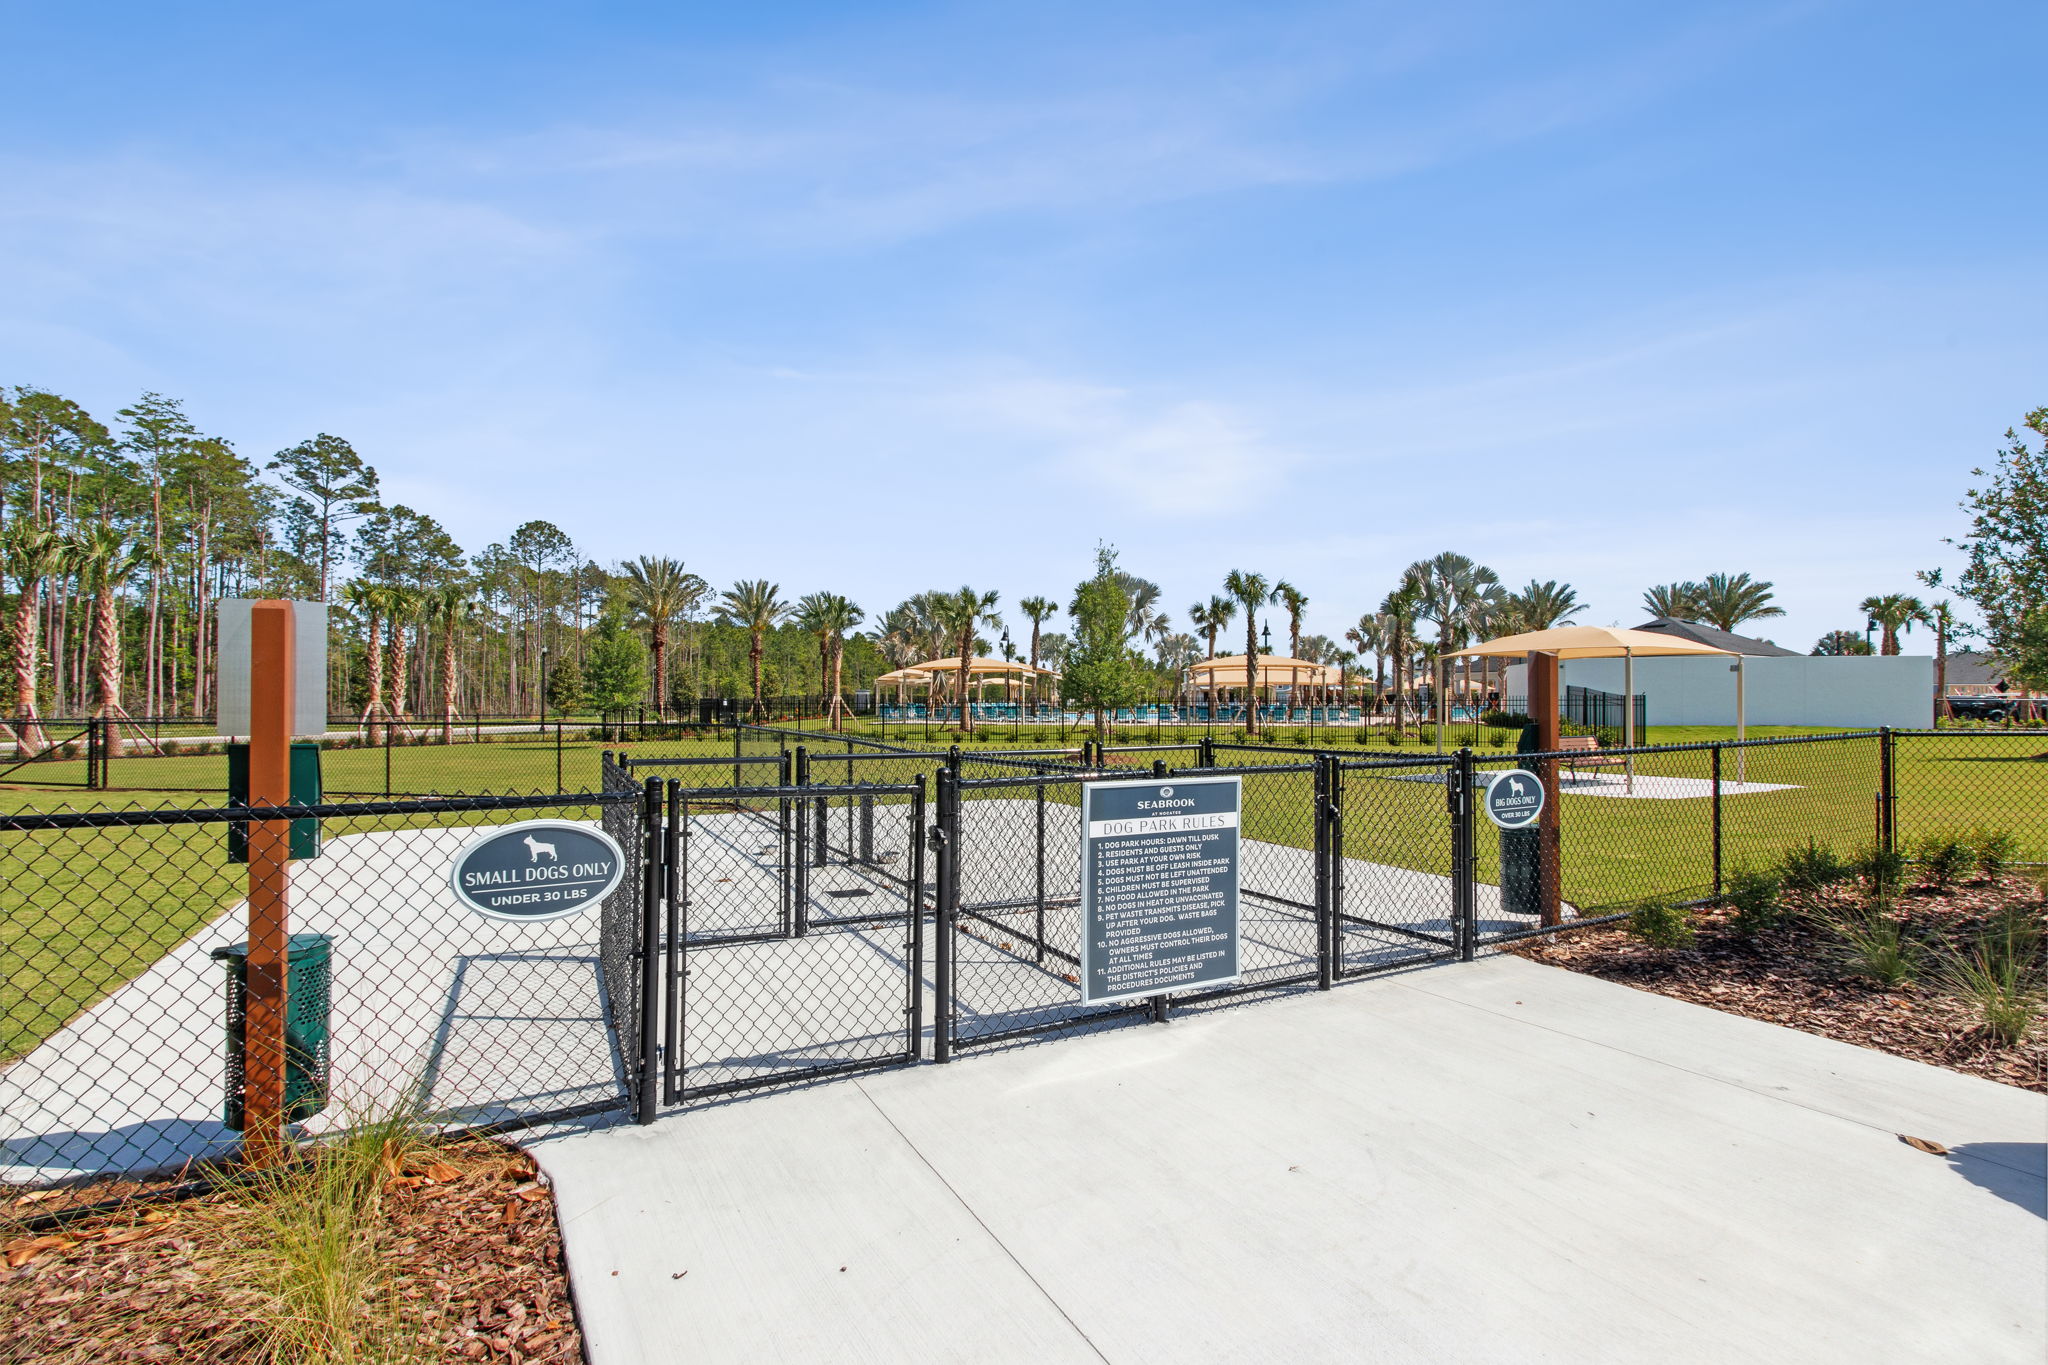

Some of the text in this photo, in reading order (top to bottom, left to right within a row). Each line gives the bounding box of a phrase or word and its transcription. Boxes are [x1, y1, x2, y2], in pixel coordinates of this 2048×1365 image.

[1137, 799, 1195, 809] SEABROOK
[1507, 797, 1521, 805] DOGS
[1104, 815, 1224, 835] DOG PARK RULES
[1106, 848, 1142, 858] RESIDENTS
[465, 862, 611, 886] SMALL DOGS ONLY
[1105, 876, 1124, 885] DOGS
[1126, 874, 1144, 882] MUST
[1187, 867, 1228, 876] UNATTENDED
[1106, 868, 1124, 876] DOGS
[1106, 884, 1140, 894] CHILDREN
[1171, 876, 1209, 886] SUPERVISED
[492, 889, 588, 906] UNDER 30 LBS
[1118, 902, 1136, 910] DOGS
[1176, 892, 1223, 903] UNVACCINATED
[1137, 890, 1168, 899] ALLOWED
[1120, 910, 1142, 918] WASTE
[1144, 906, 1181, 916] TRANSMITS
[1182, 903, 1209, 911] DISEASE,
[1117, 919, 1138, 928] AFTER
[1140, 917, 1158, 925] YOUR
[1178, 912, 1200, 920] WASTE
[1106, 928, 1141, 938] PROVIDED
[1121, 934, 1162, 945] AGGRESSIVE
[1182, 927, 1213, 937] ALLOWED,
[1109, 946, 1139, 955] OWNERS
[1160, 939, 1190, 948] CONTROL
[1107, 963, 1148, 974] ADDITIONAL
[1150, 959, 1171, 968] RULES
[1197, 952, 1217, 960] LISTED
[1133, 953, 1152, 962] TIMES
[1123, 970, 1158, 980] DISTRICT'S
[1160, 965, 1188, 974] POLICIES
[1107, 972, 1194, 992] PROCEDURES DOCUMENTS
